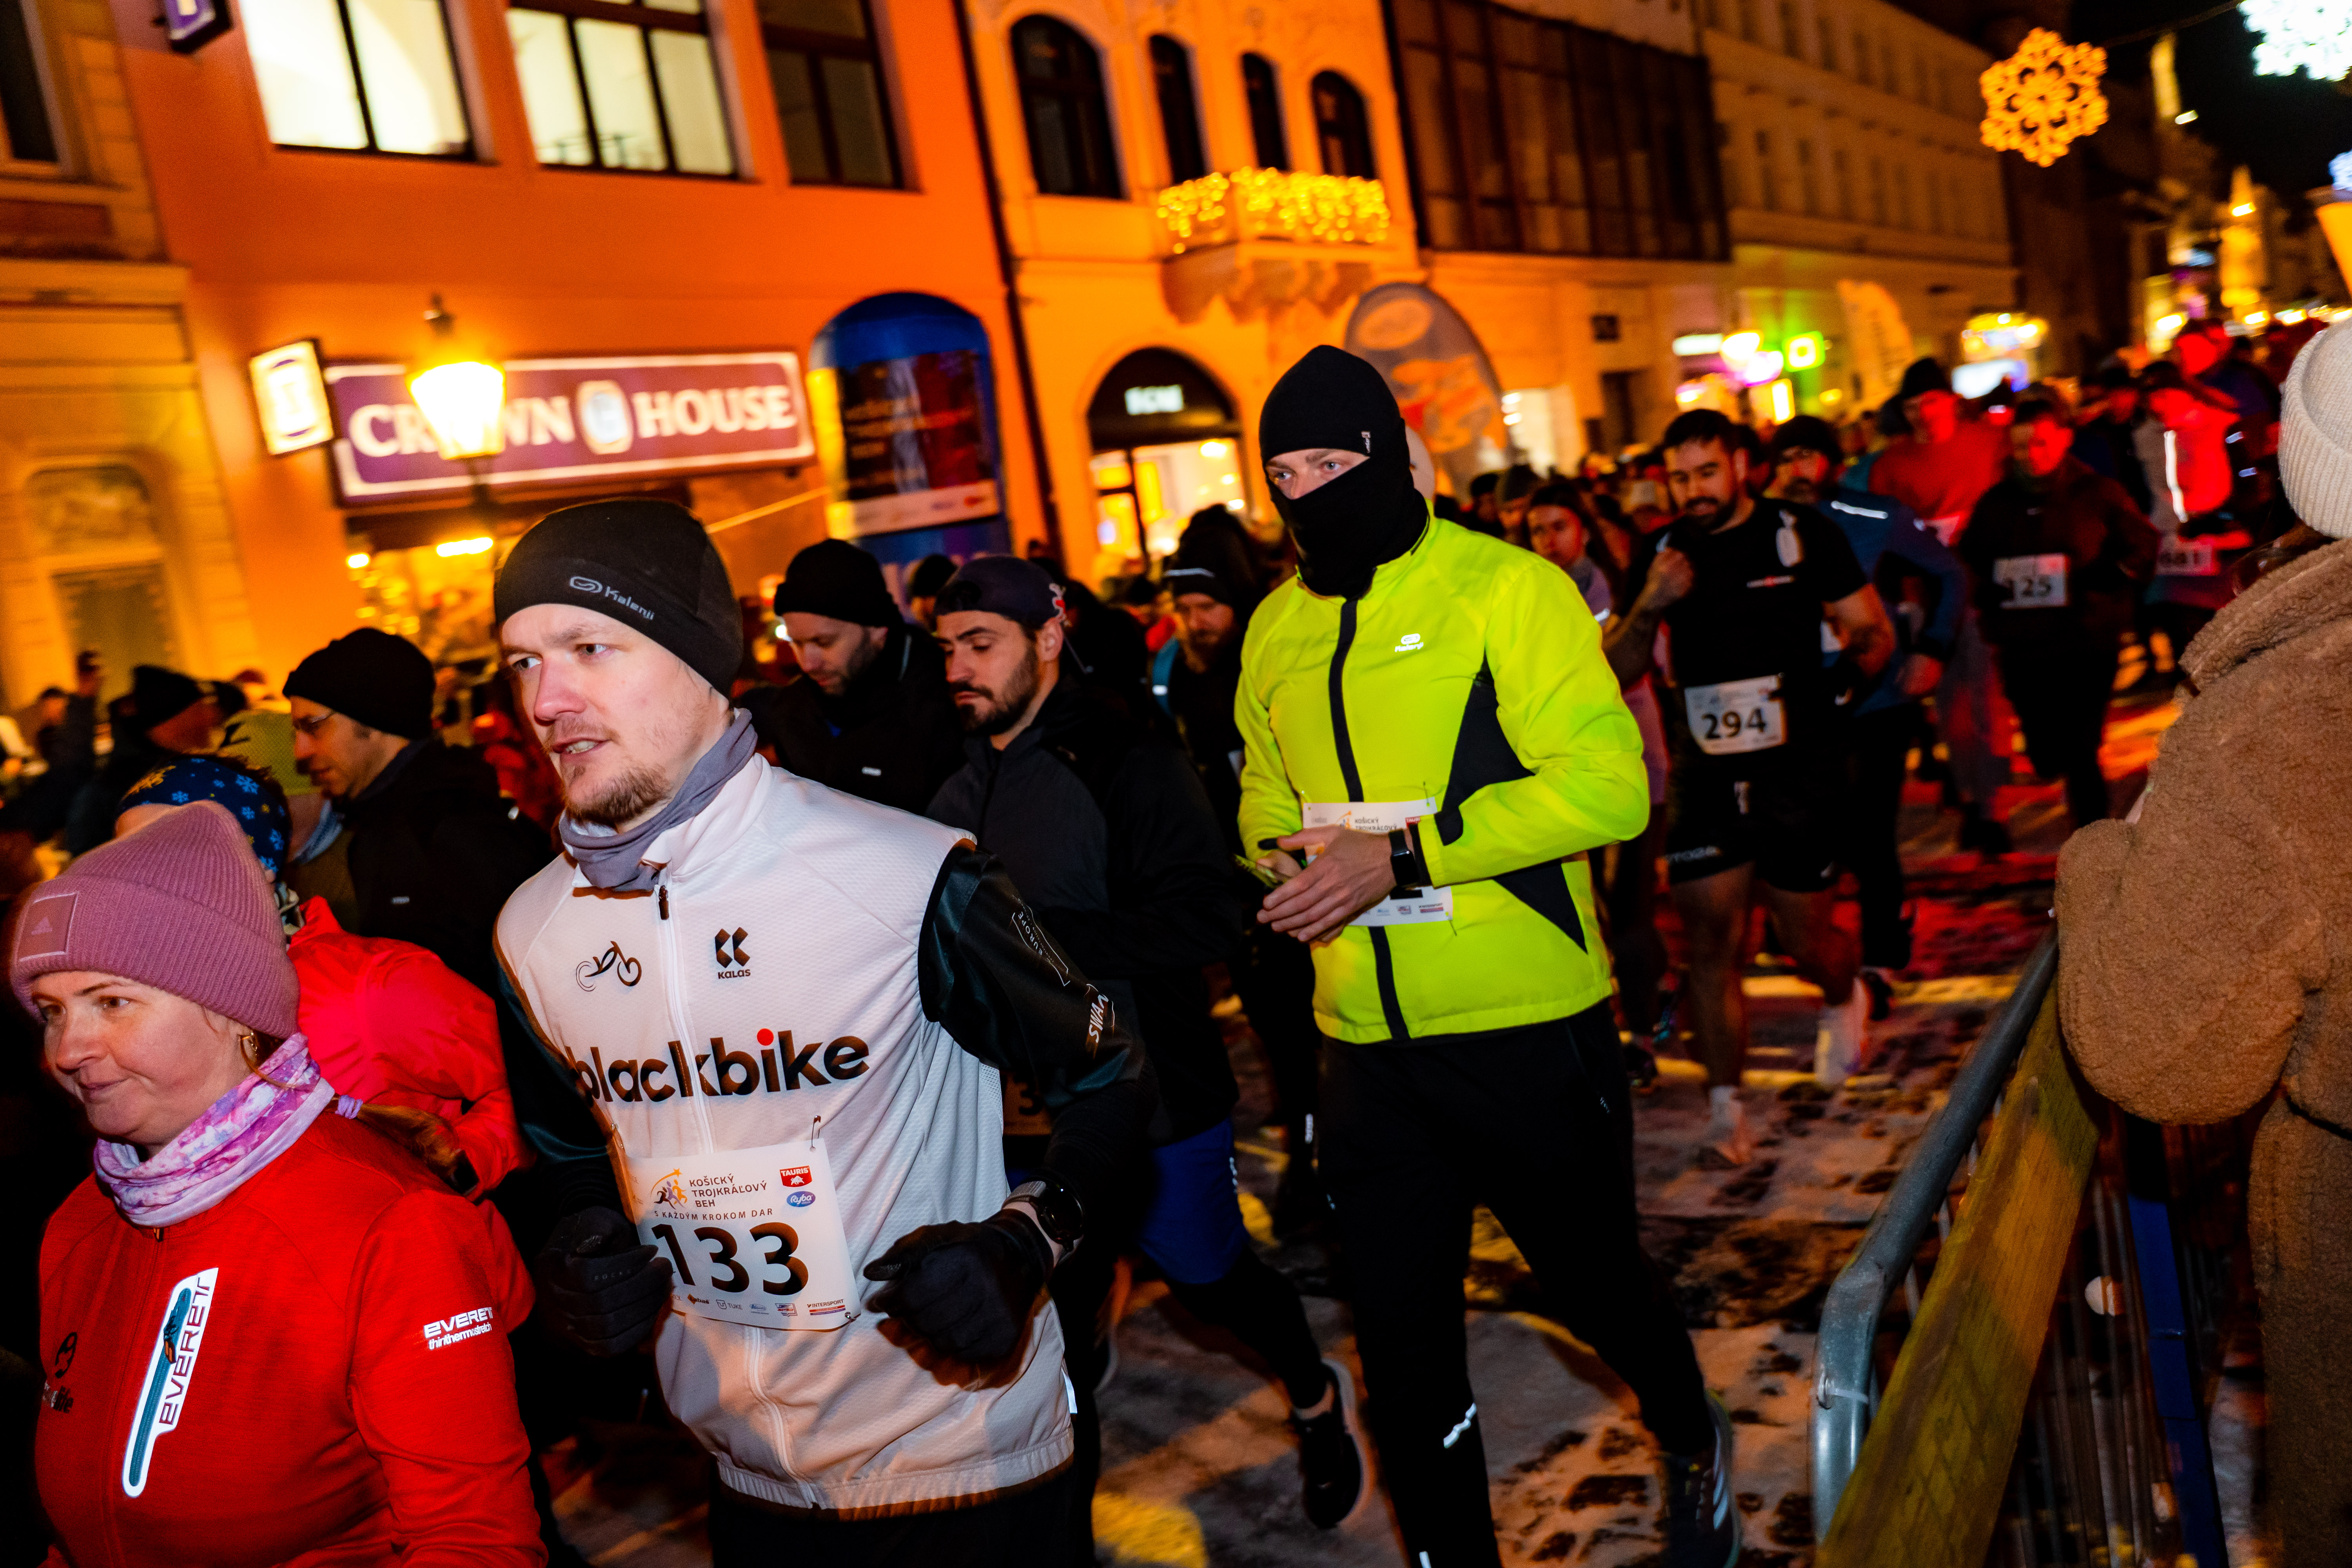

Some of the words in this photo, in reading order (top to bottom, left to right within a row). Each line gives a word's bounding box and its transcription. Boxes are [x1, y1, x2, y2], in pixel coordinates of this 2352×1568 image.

[349, 395, 575, 457] CRWN
[632, 385, 797, 439] HOUSE
[1701, 708, 1767, 739] 294
[1018, 911, 1043, 955] EUROPE
[718, 969, 751, 979] KALAS
[1089, 994, 1109, 1043] SWAN
[565, 1028, 870, 1102] blackbike
[689, 1173, 735, 1187] KOŠICKÝ
[780, 1167, 809, 1176] TAURIS
[691, 1180, 767, 1198] TROJKRÁĽOVÝ
[695, 1199, 715, 1207] BEH
[790, 1194, 812, 1205] Ryba
[662, 1210, 698, 1220] KAŽDÝM
[702, 1211, 746, 1220] KROKOM
[751, 1208, 773, 1217] DAR
[651, 1222, 809, 1296] 133
[812, 1299, 844, 1308] INTERSPORT
[159, 1277, 210, 1425] EVERETT
